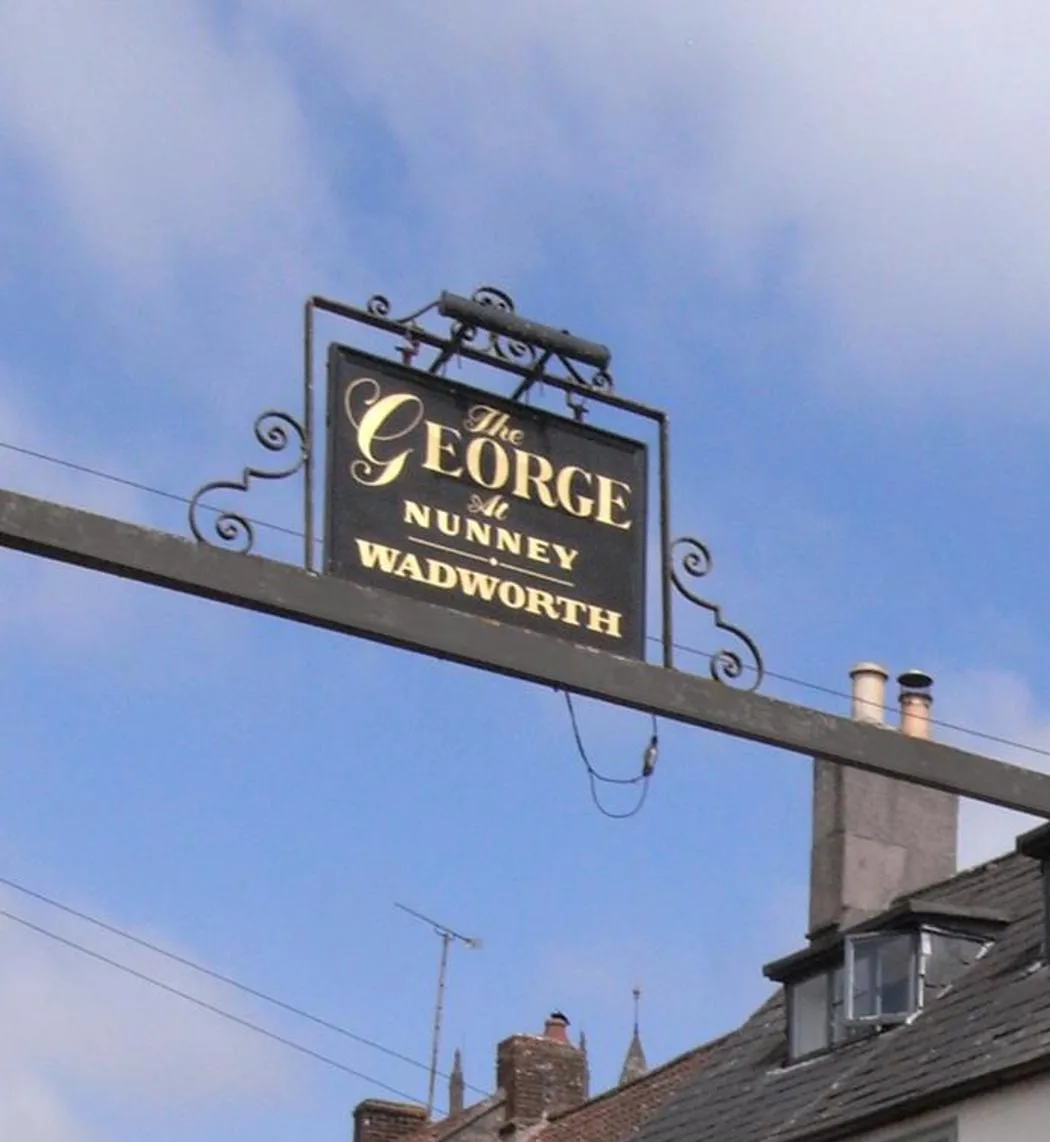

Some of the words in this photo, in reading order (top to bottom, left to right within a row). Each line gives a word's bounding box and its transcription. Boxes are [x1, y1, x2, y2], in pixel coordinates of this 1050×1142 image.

[345, 378, 632, 530] GEORGE
[464, 404, 524, 446] The
[403, 500, 579, 571] NUNNEY
[467, 494, 514, 521] At
[355, 538, 622, 638] WADWORTH
